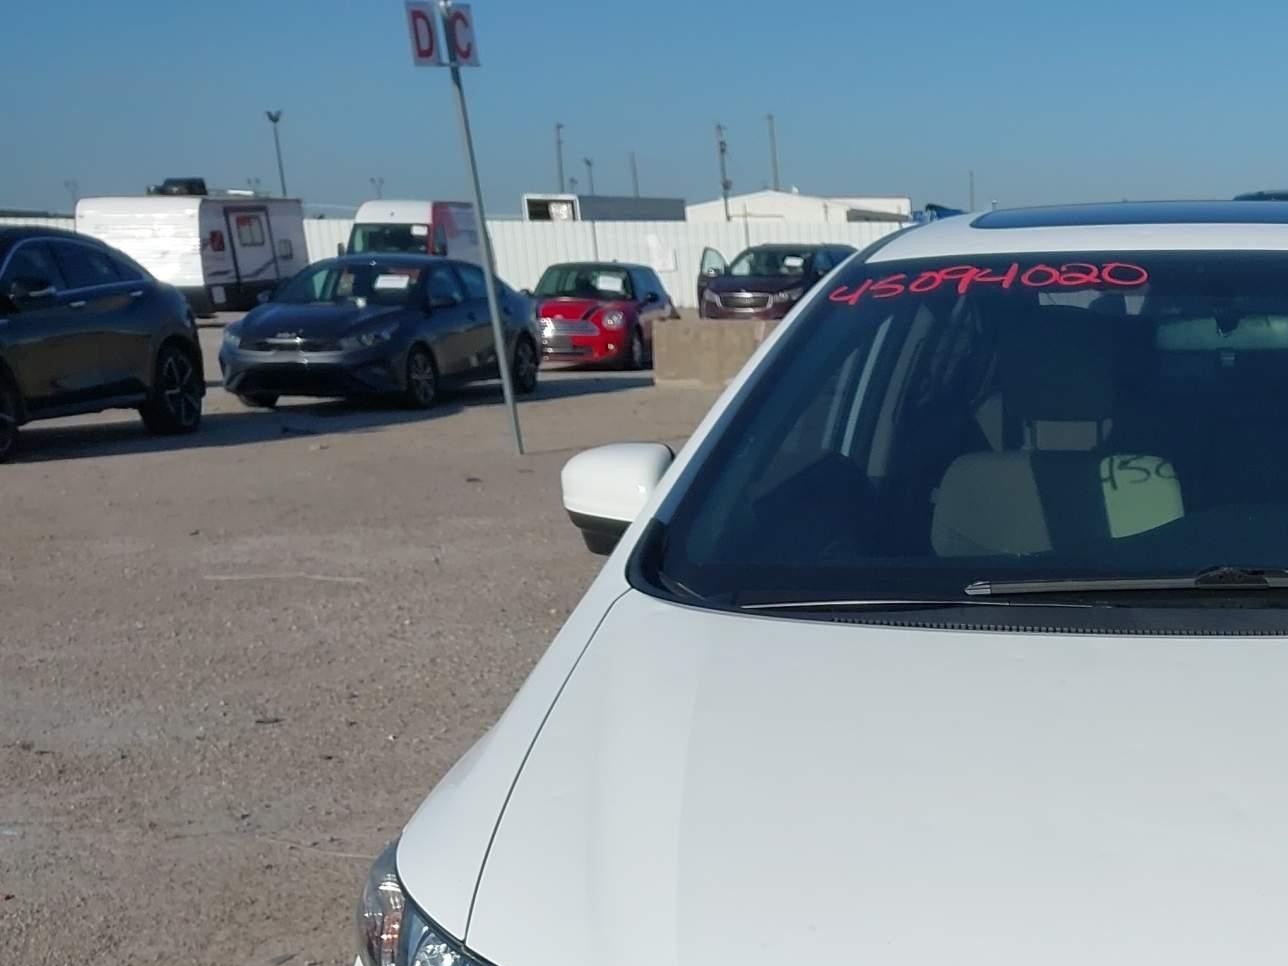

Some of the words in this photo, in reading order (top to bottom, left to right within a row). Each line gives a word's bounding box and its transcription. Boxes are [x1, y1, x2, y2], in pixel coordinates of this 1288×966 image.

[411, 10, 434, 58] D
[449, 10, 472, 59] C
[829, 262, 1149, 305] 45094020
